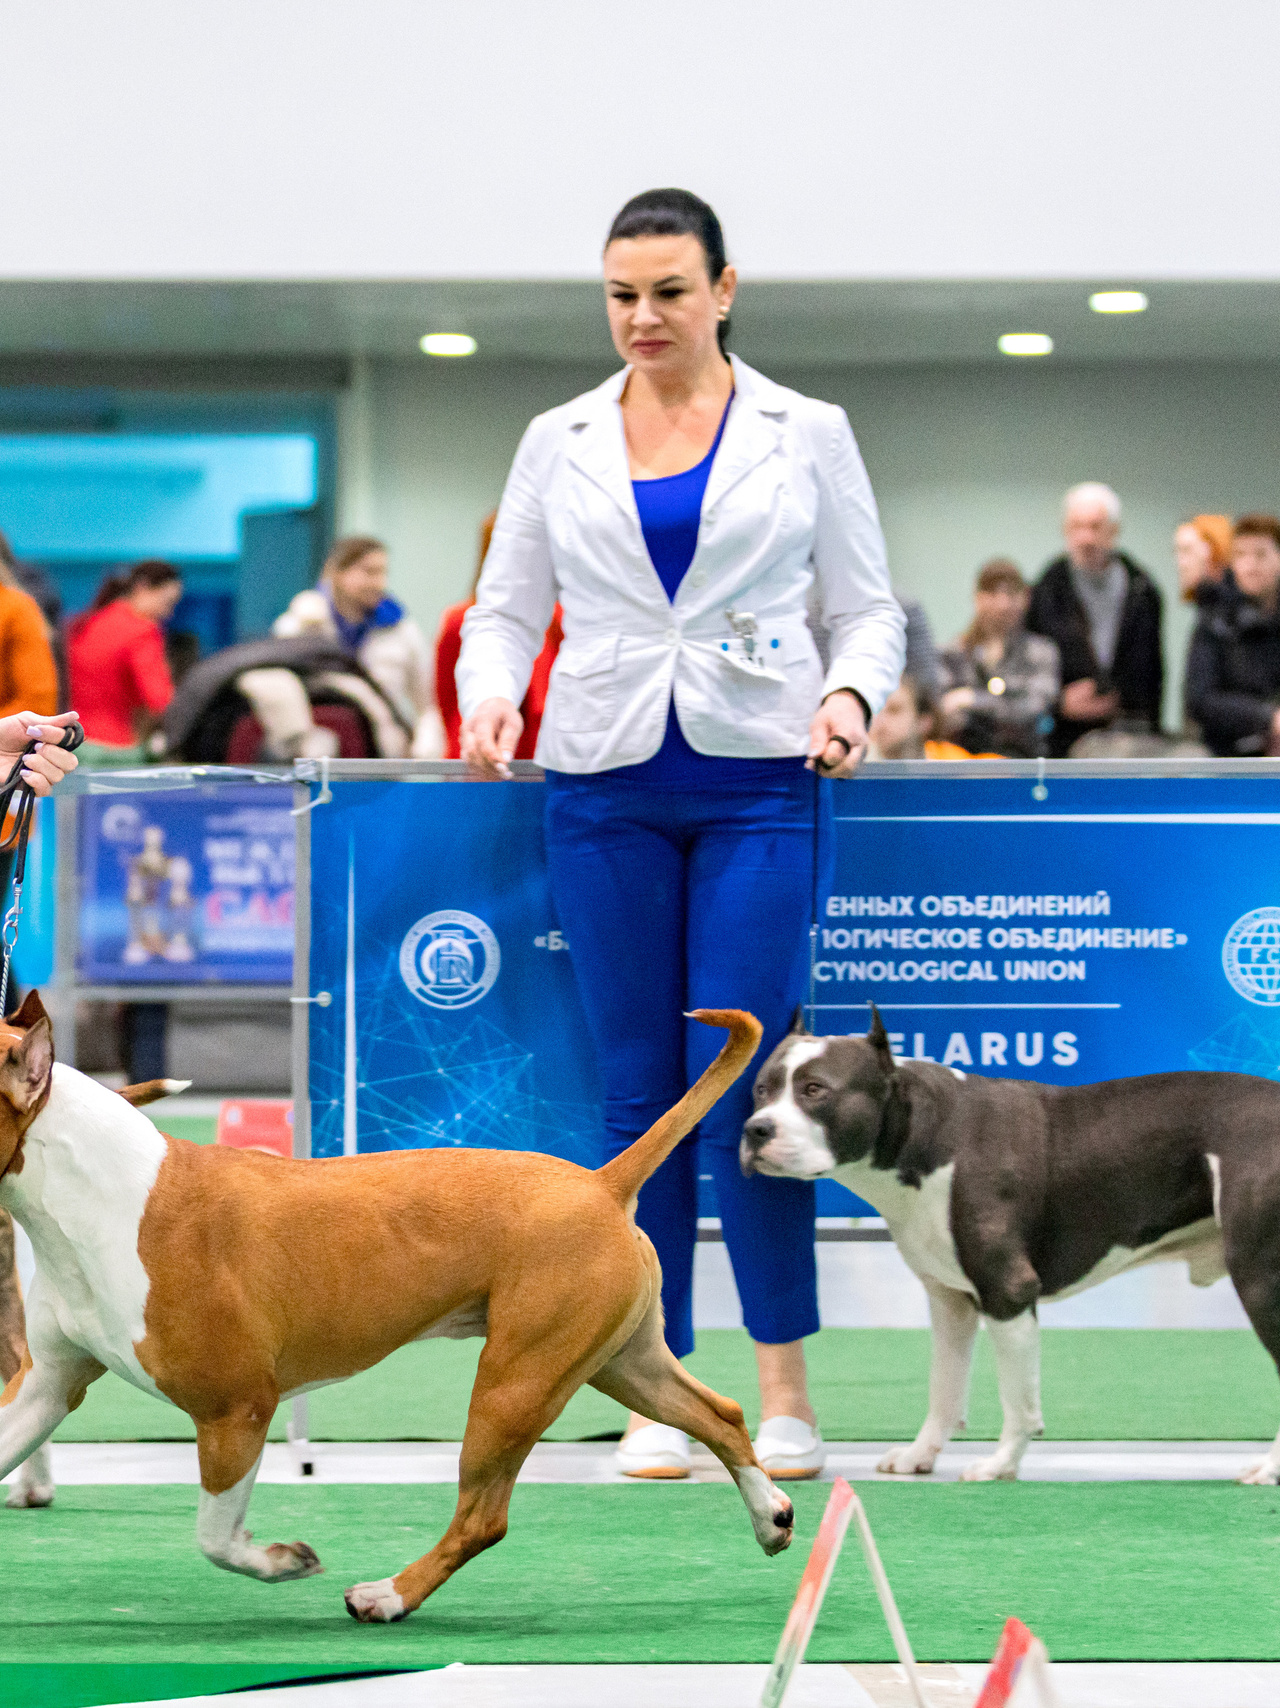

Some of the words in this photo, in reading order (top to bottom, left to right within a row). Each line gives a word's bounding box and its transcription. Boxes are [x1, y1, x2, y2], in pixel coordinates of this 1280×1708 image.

[920, 890, 1111, 919] ОБЪЕДИНЕНИЙ
[987, 927, 1188, 951] ОБЪЕДИНЕНИЕ»
[813, 960, 999, 982] CYNOLOGICAL
[1004, 959, 1086, 981] UNION
